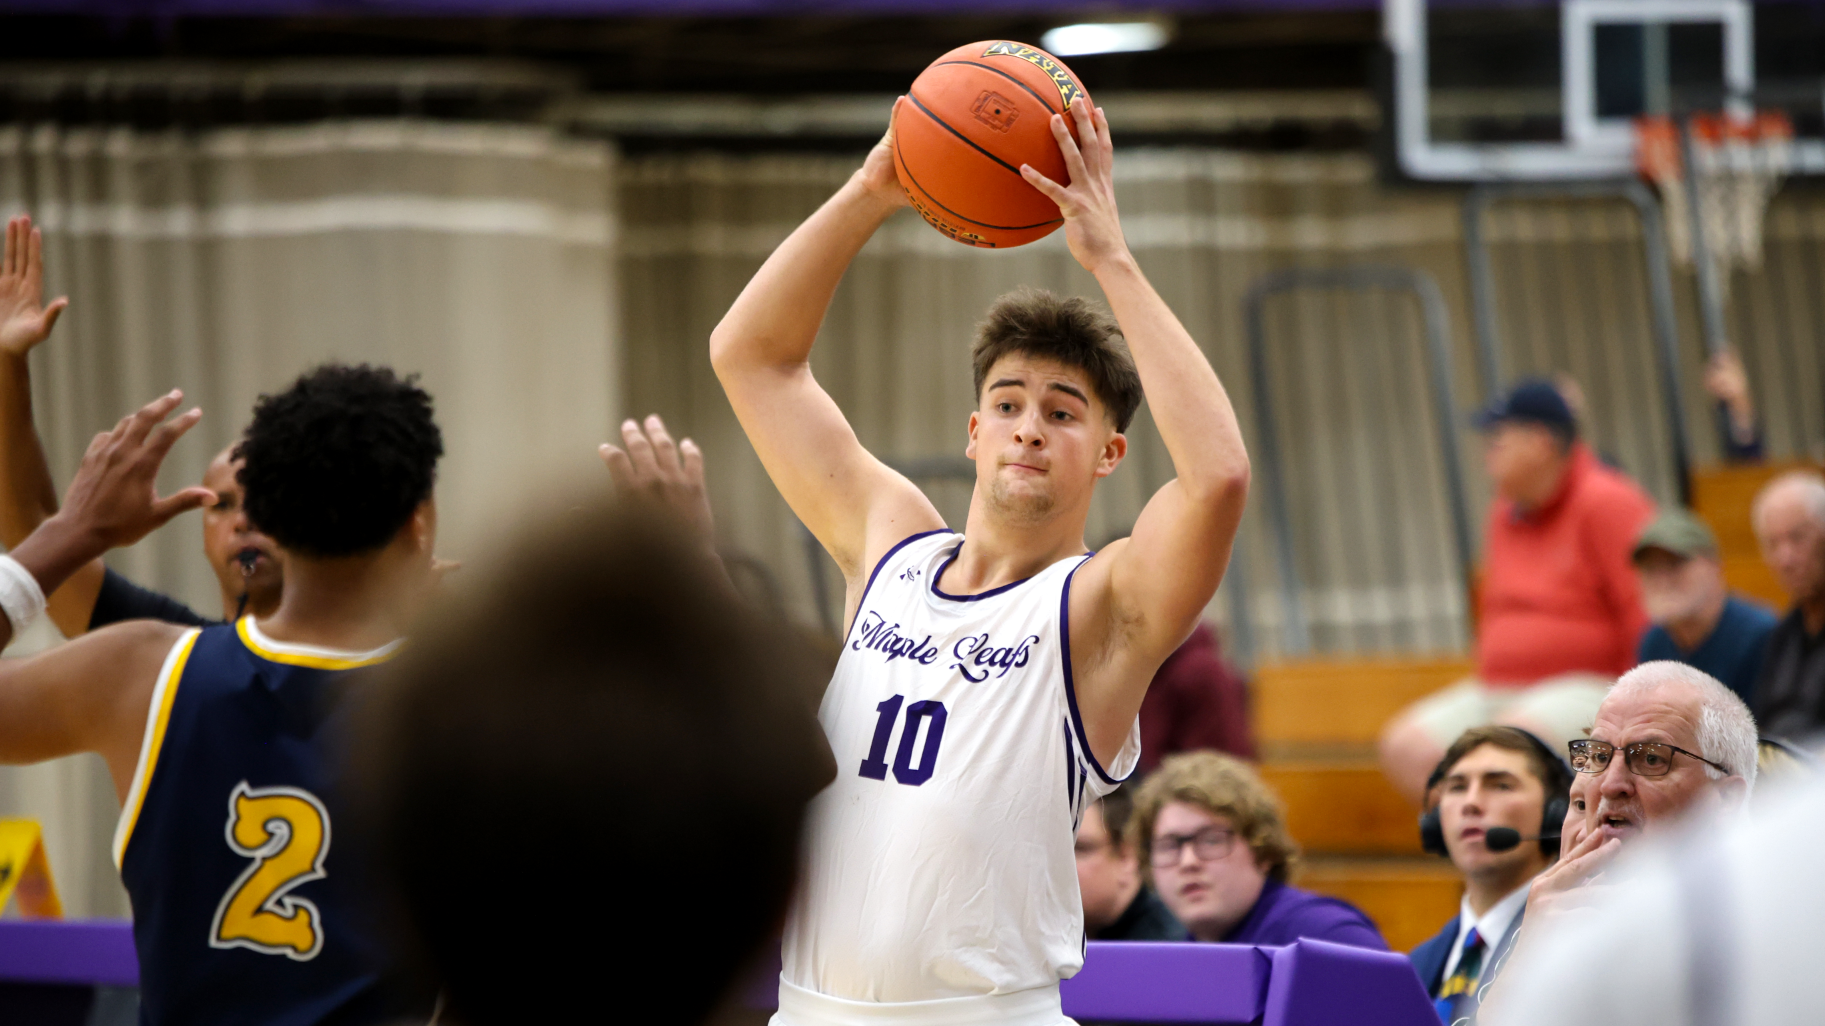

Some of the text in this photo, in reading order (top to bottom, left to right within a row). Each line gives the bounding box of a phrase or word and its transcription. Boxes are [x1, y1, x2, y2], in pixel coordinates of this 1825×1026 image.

[981, 41, 1084, 112] NAIA
[852, 610, 1040, 684] Maple Leafs
[858, 694, 948, 787] 10
[208, 779, 332, 962] 2
